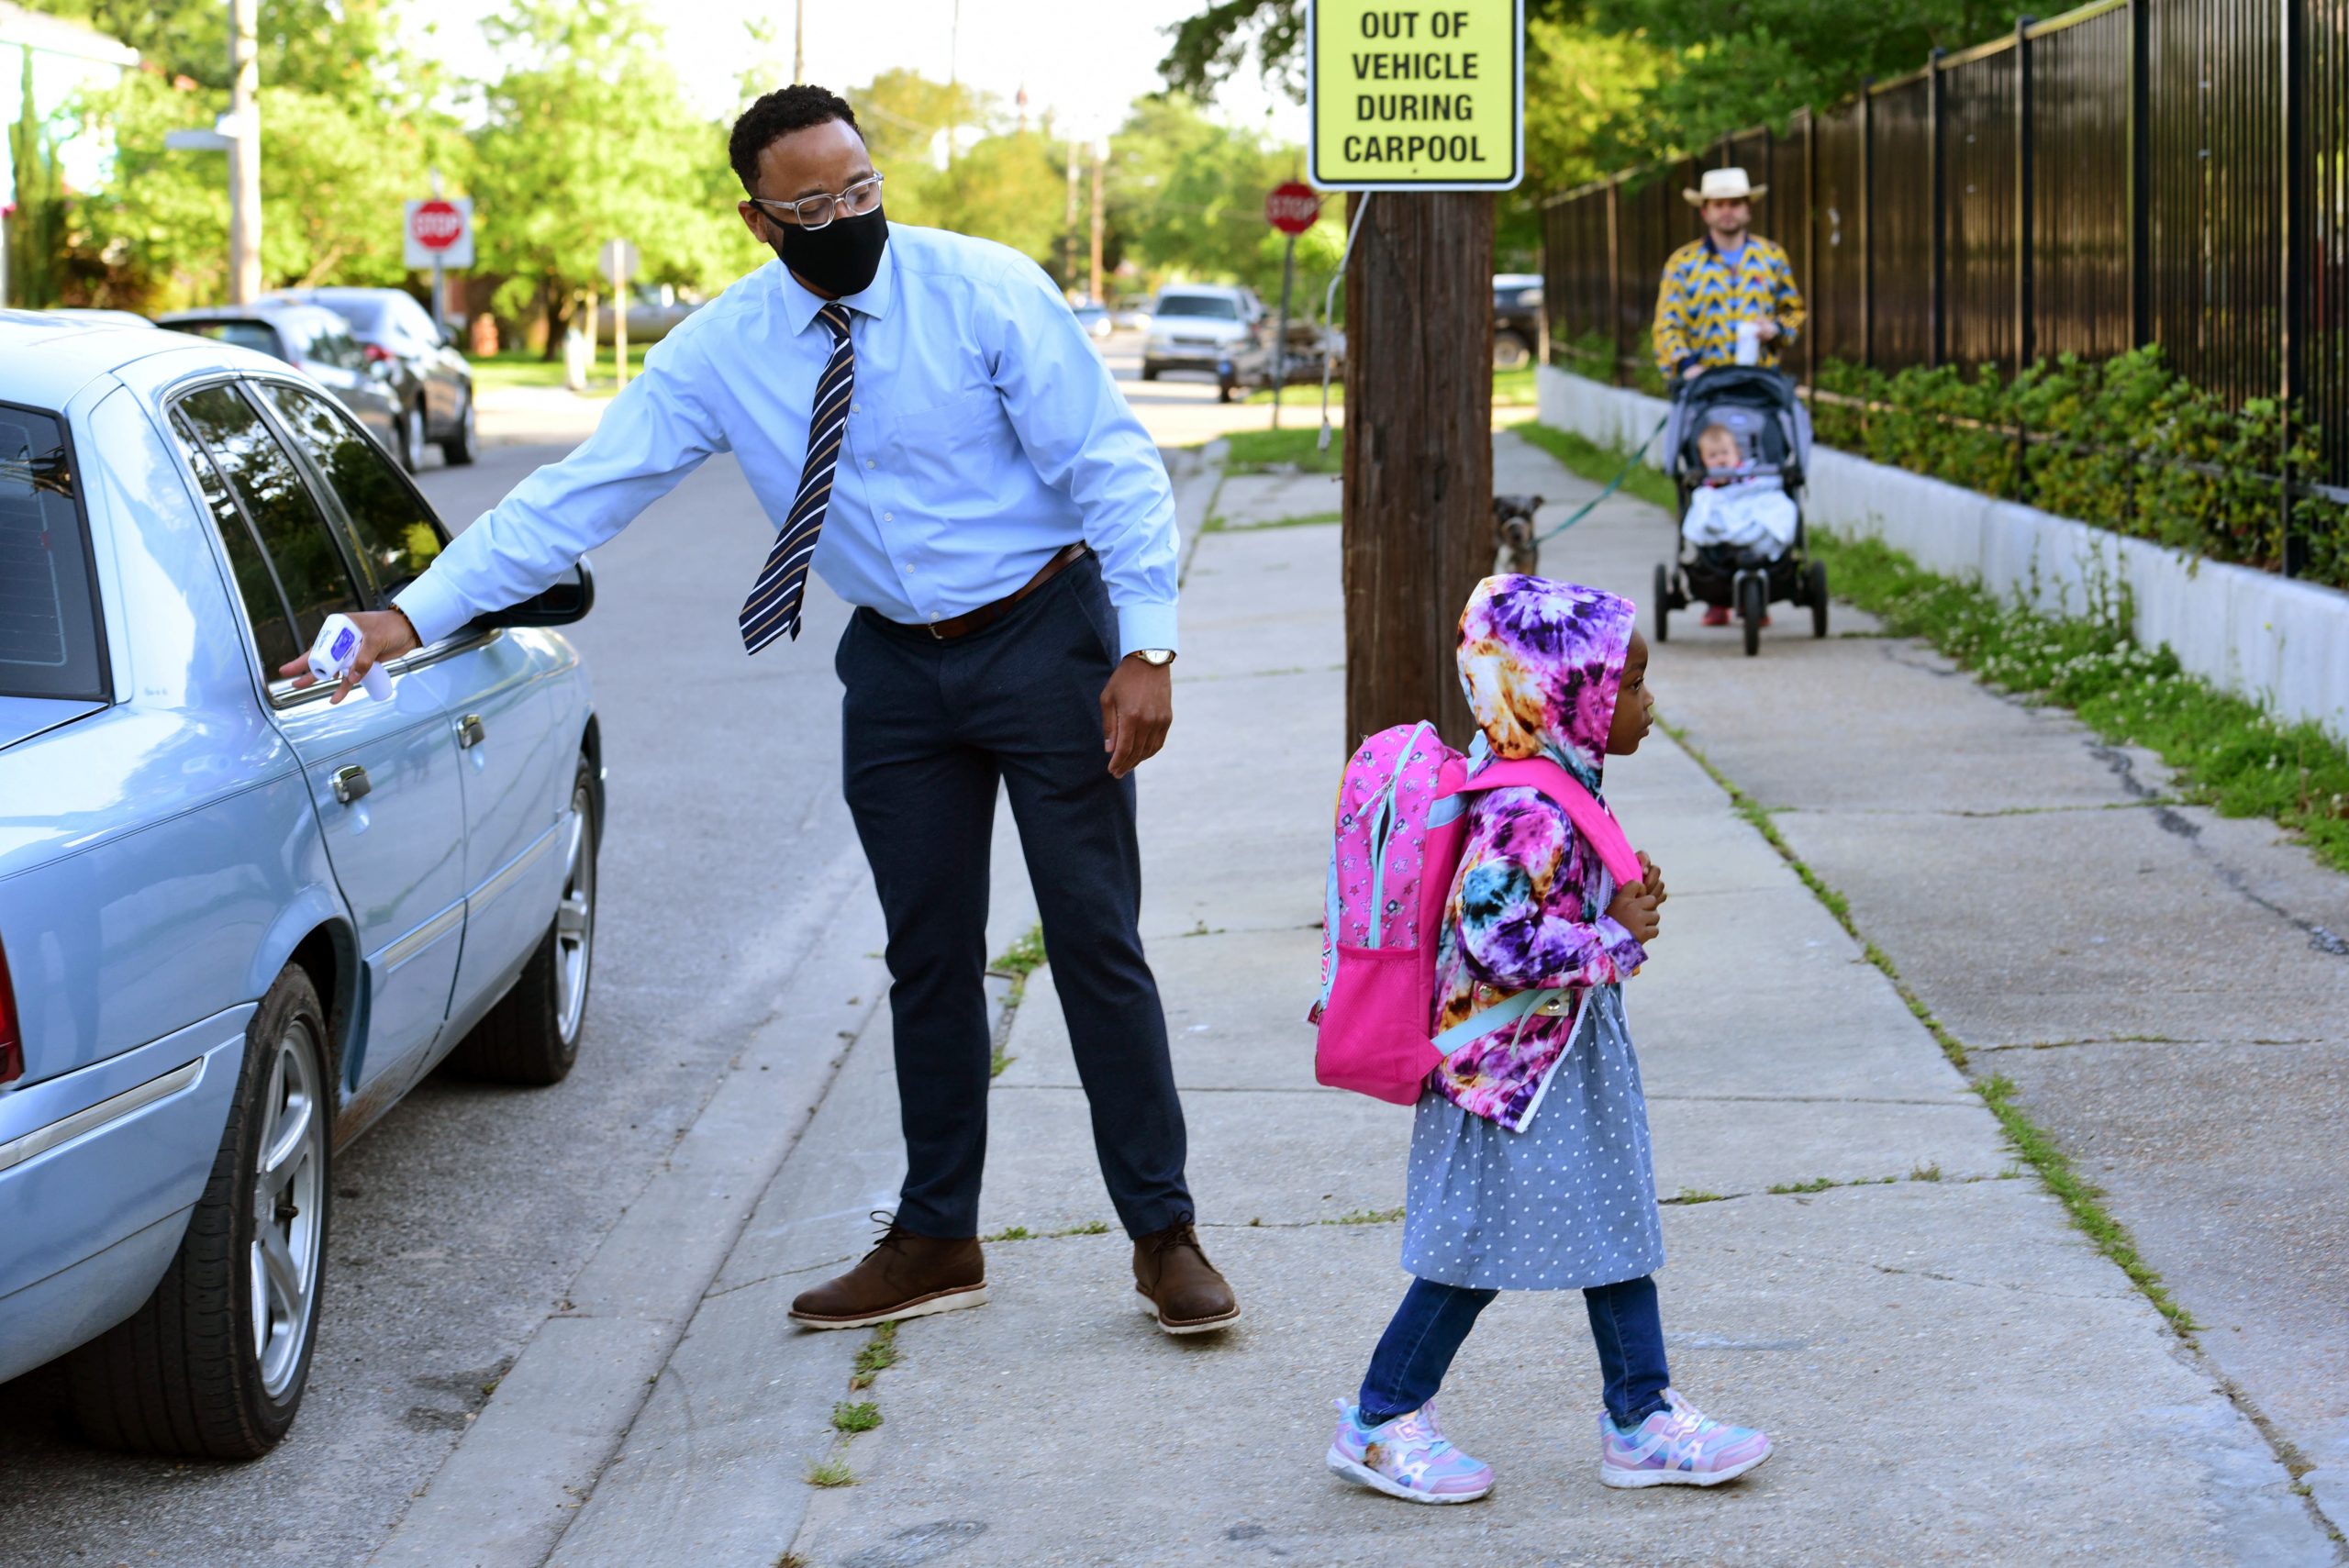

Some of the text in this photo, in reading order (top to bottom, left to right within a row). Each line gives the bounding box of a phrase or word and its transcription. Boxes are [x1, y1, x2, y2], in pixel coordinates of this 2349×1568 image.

[1361, 11, 1469, 39] OUT OF
[1352, 52, 1478, 81] VEHICLE
[1356, 94, 1473, 122] DURING
[1343, 135, 1486, 162] CARPOOL
[1268, 195, 1317, 219] STOP
[413, 212, 460, 237] STOP
